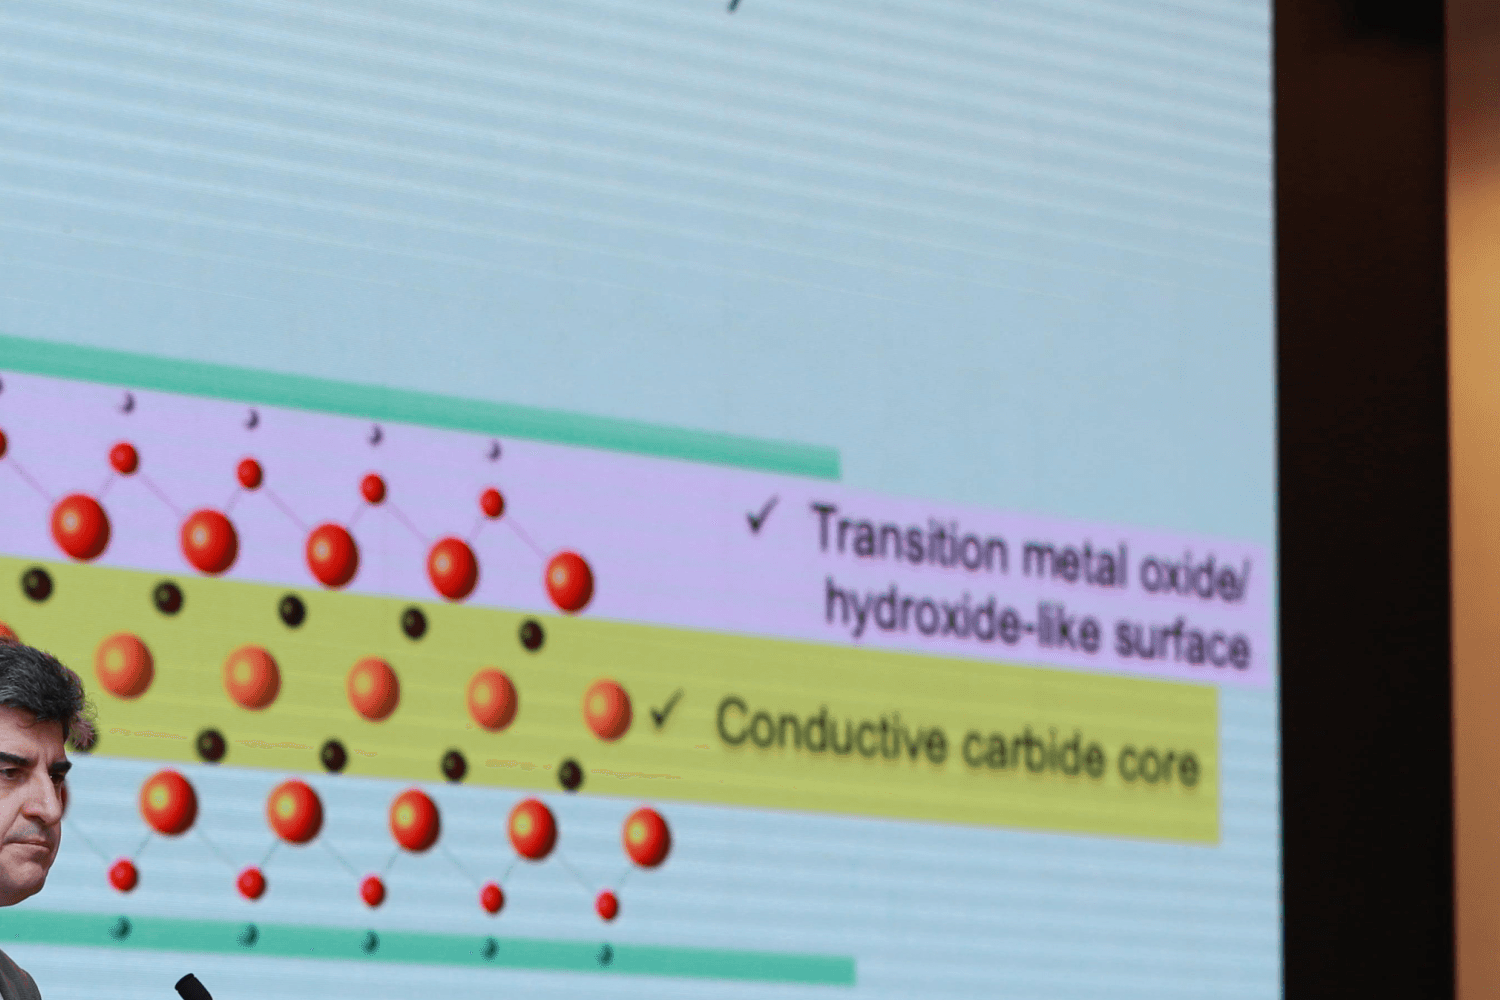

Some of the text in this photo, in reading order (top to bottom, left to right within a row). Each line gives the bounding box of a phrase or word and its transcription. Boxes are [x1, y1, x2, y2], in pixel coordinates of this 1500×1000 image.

[811, 502, 1251, 602] Transition metal oxide/
[825, 575, 1251, 671] hydroxide-like surface
[716, 695, 1201, 787] Conductive carbide core
